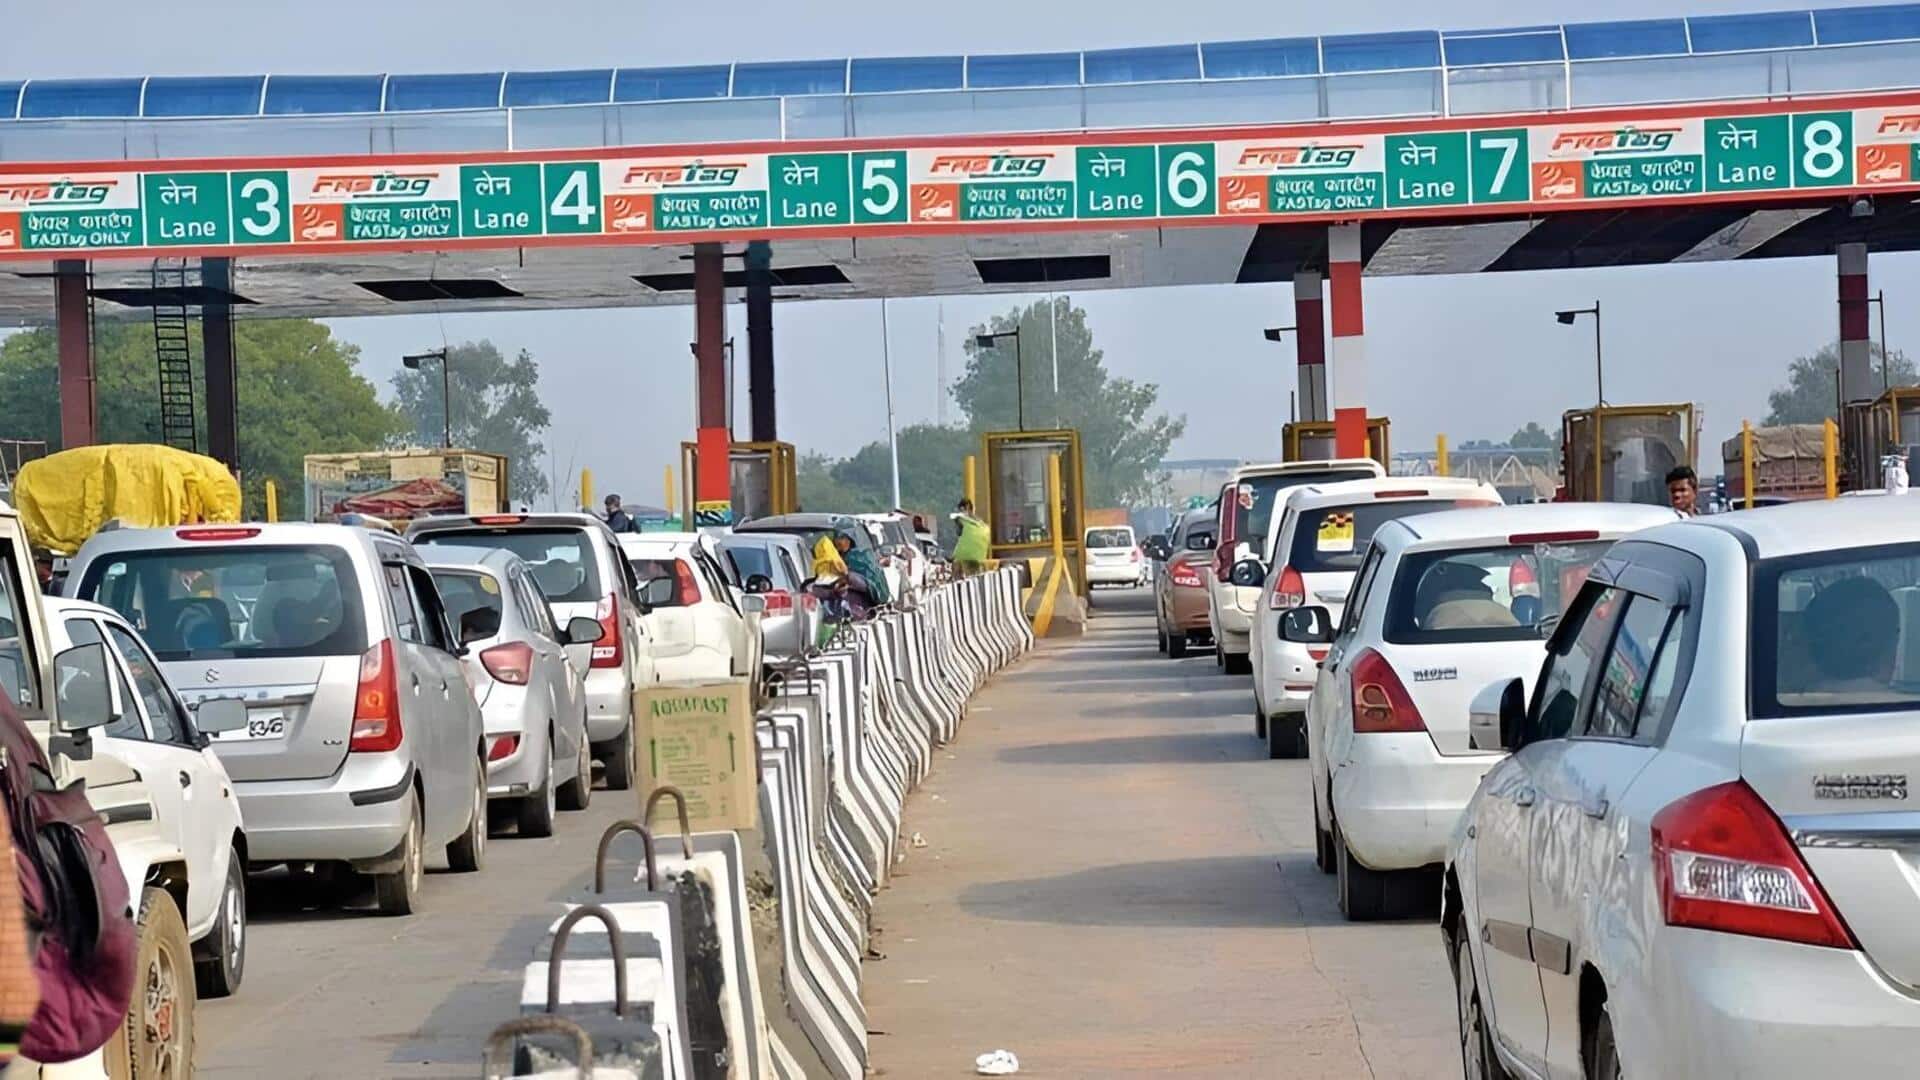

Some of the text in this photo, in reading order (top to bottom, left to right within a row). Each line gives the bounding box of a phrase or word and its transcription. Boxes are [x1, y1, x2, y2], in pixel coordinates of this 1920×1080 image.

[1718, 122, 1757, 149] लेन
[1398, 140, 1438, 165] लेन
[1803, 120, 1844, 178] 8
[783, 160, 818, 185] लेन
[1089, 152, 1126, 178] लेन
[1480, 138, 1519, 195] 7
[1718, 162, 1776, 183] Lane
[473, 170, 511, 195] लेन
[862, 159, 899, 215] 5
[1167, 151, 1208, 208] 6
[1399, 178, 1455, 199] Lane
[1652, 178, 1693, 193] ONLY
[159, 178, 197, 205] लेन
[551, 170, 596, 225] 4
[1089, 190, 1143, 211] Lane
[1335, 195, 1374, 208] ONLY
[241, 178, 280, 236] 3
[474, 209, 529, 228] Lane
[783, 198, 837, 218] Lane
[1026, 204, 1065, 217] ONLY
[160, 217, 216, 238] Lane
[411, 224, 449, 236] ONLY
[719, 213, 758, 227] ONLY
[90, 231, 131, 245] ONLY
